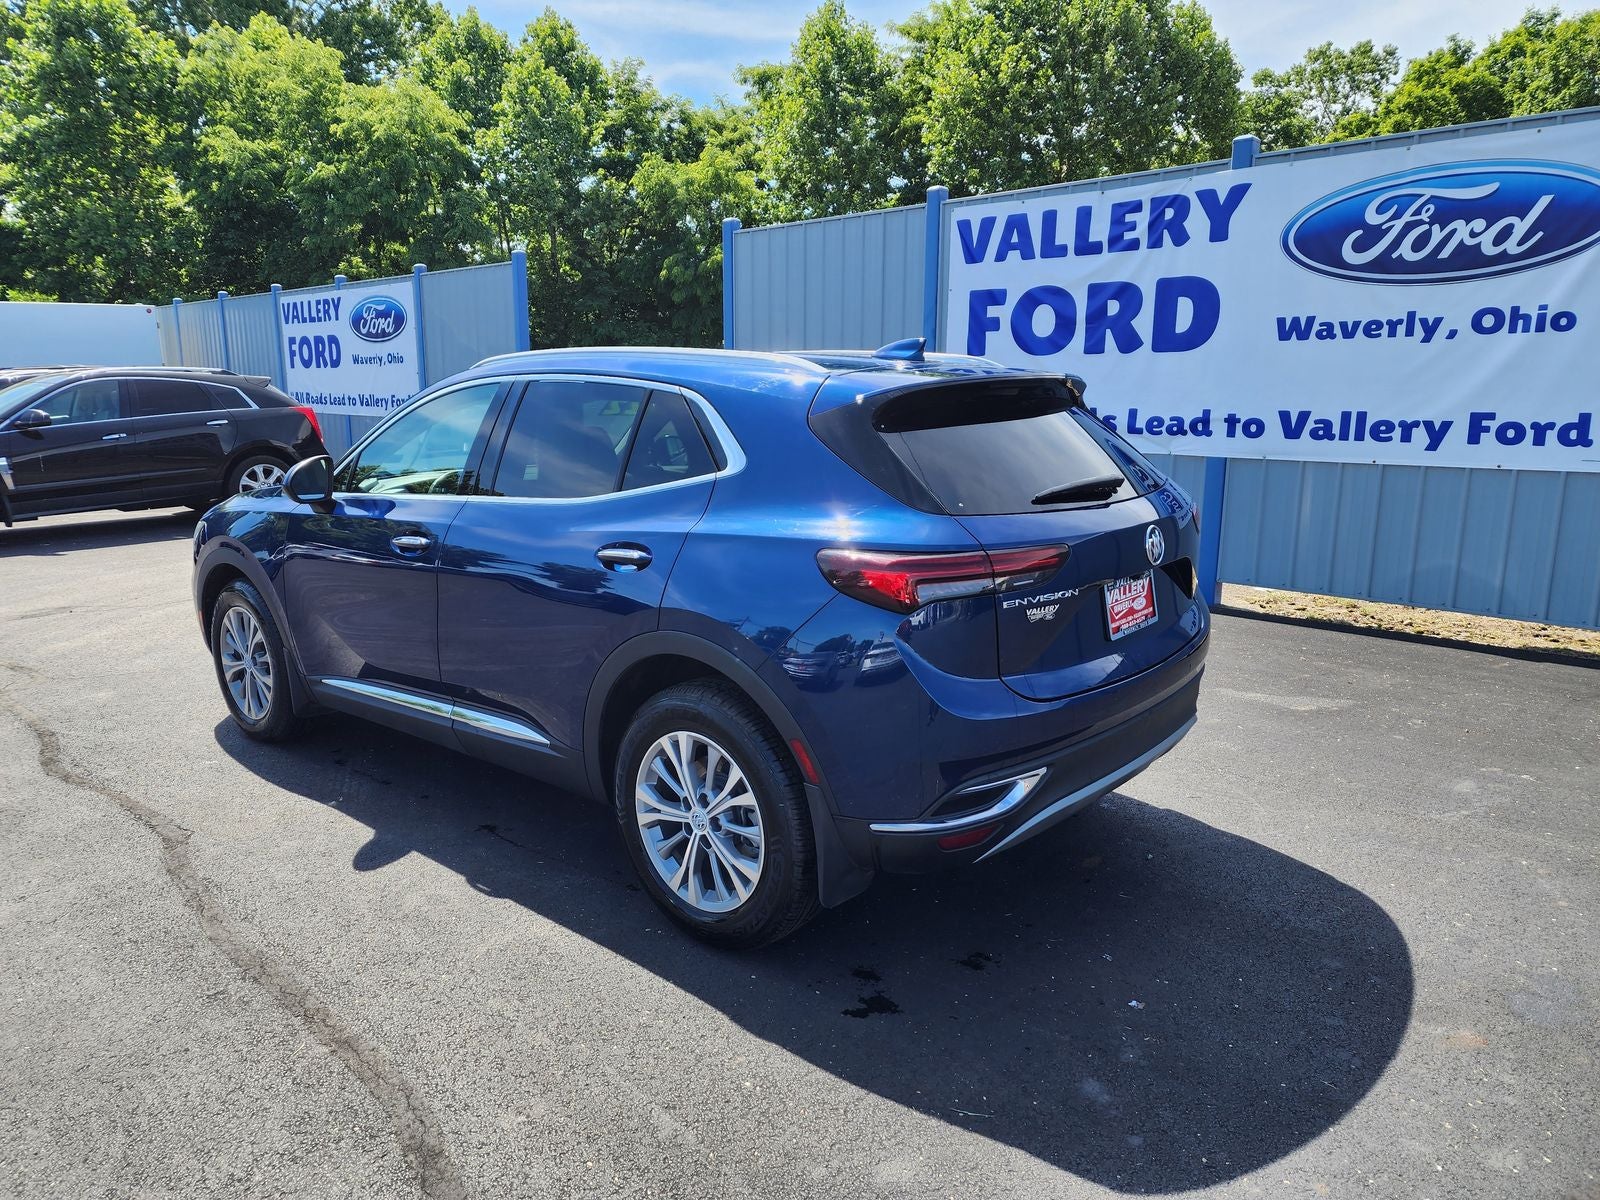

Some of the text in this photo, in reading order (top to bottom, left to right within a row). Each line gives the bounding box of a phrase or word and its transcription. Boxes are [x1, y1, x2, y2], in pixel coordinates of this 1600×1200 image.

[955, 183, 1252, 265] VALLERY
[1342, 182, 1555, 265] Ford
[281, 296, 342, 325] VALLERY
[360, 303, 395, 334] Ford
[967, 275, 1221, 357] FORD
[1276, 304, 1577, 343] Waverly, Ohio
[288, 334, 342, 369] FORD
[351, 352, 404, 367] Waverly, Ohio
[305, 393, 328, 406] Roads
[329, 393, 346, 406] Lead
[347, 394, 357, 406] to
[358, 393, 389, 411] Vallery
[1127, 407, 1213, 438] Lead
[1224, 413, 1265, 439] to
[1278, 410, 1454, 452] Vallery
[1467, 411, 1594, 448] Ford
[1002, 588, 1079, 609] ENVISION
[1106, 576, 1150, 605] VALLERY
[1026, 603, 1060, 616] VALLERY
